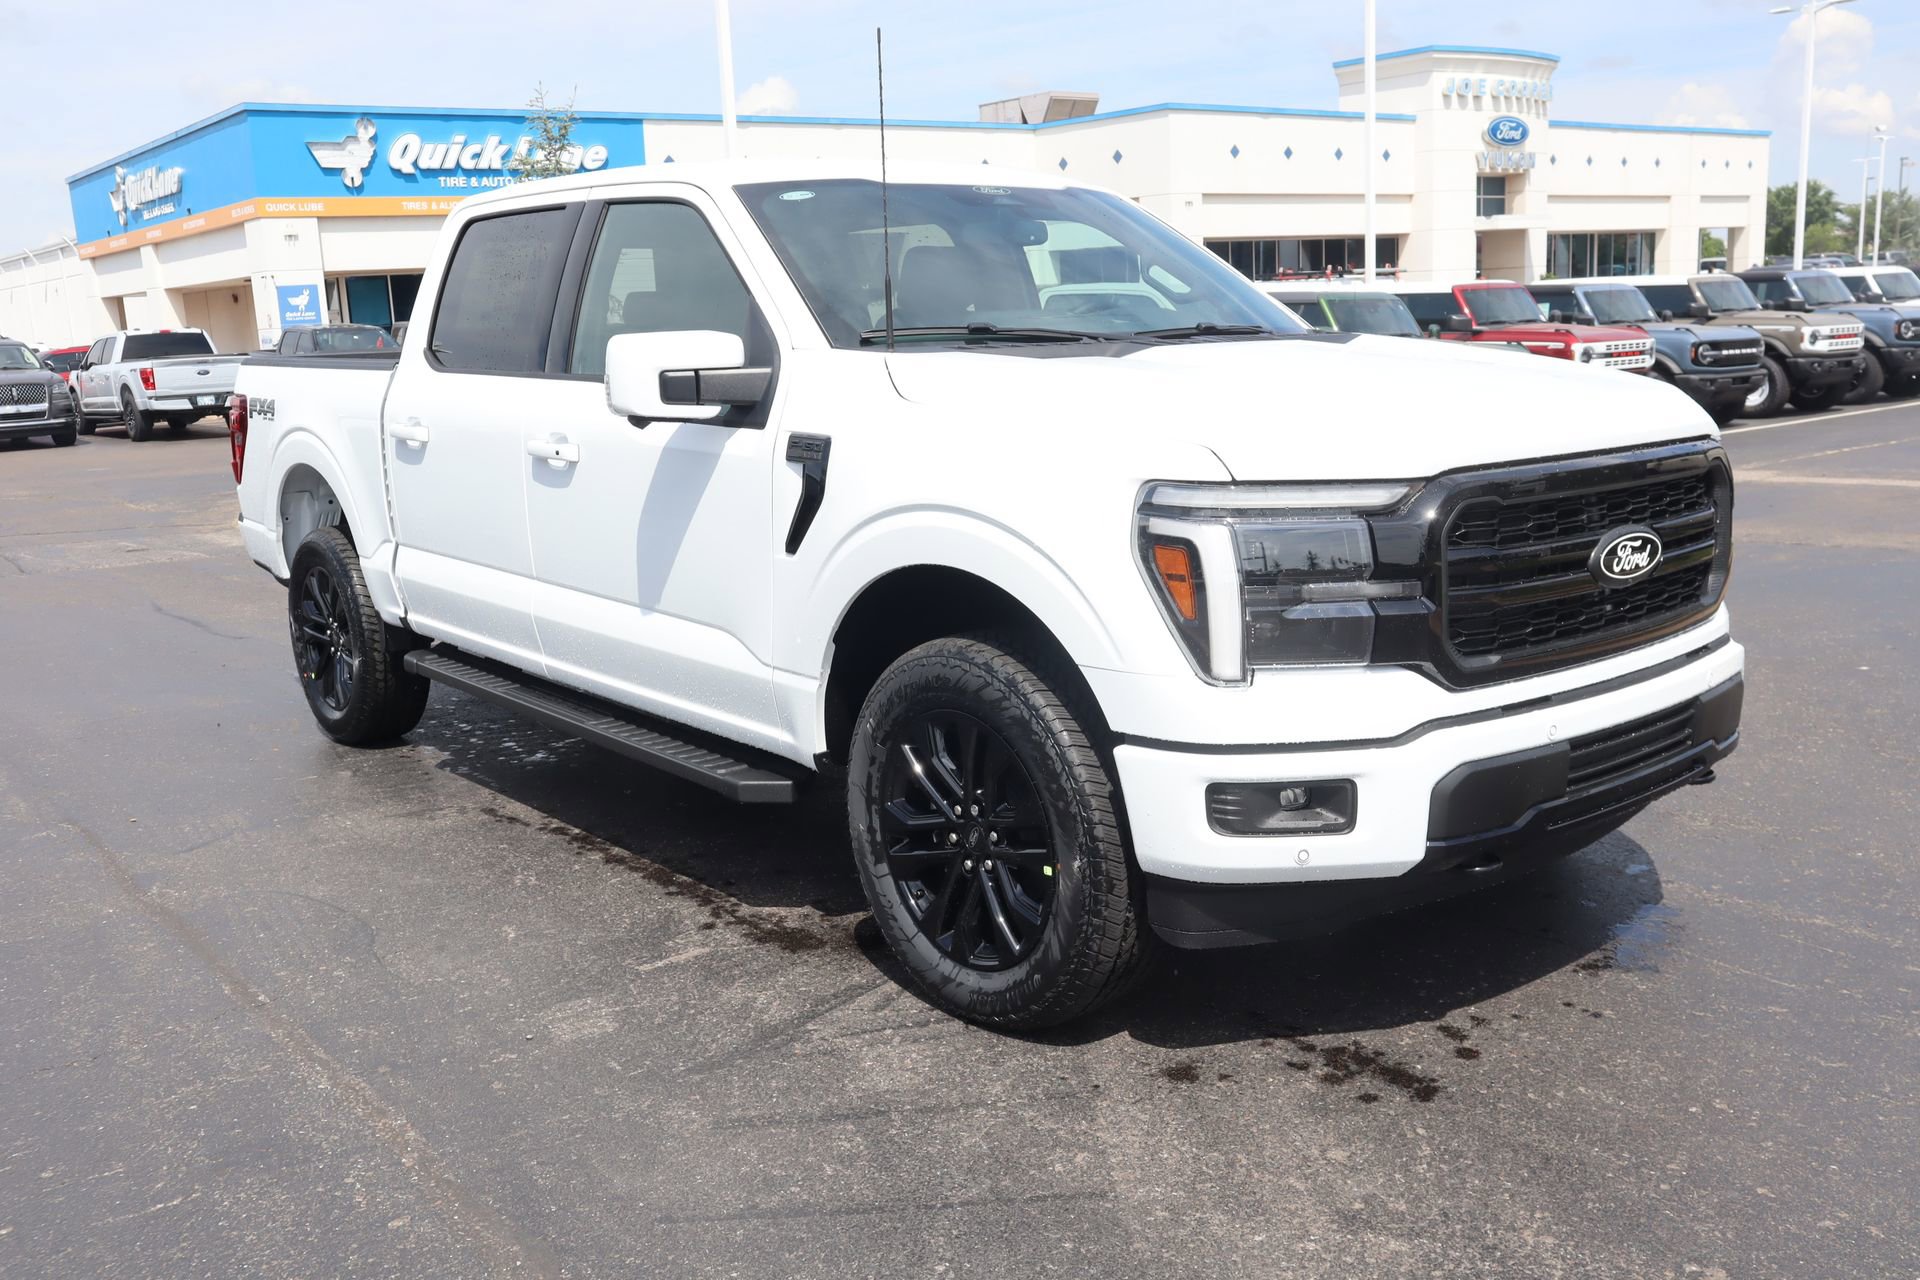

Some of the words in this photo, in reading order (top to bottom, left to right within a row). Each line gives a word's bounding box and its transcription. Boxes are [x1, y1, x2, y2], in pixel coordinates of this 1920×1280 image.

[1442, 78, 1488, 97] JOE
[1496, 121, 1523, 140] Ford
[389, 133, 512, 174] Quick
[1477, 151, 1537, 169] YUKON
[125, 168, 151, 211] Quick
[150, 165, 183, 200] Lane
[438, 176, 468, 188] TIRE
[470, 176, 479, 188] &
[481, 176, 514, 188] AUTO
[265, 202, 297, 212] QUICK
[299, 202, 324, 212] LUBE
[400, 201, 428, 210] TIRES
[431, 201, 438, 210] &
[249, 397, 276, 419] FX4
[1612, 539, 1652, 573] Ford
